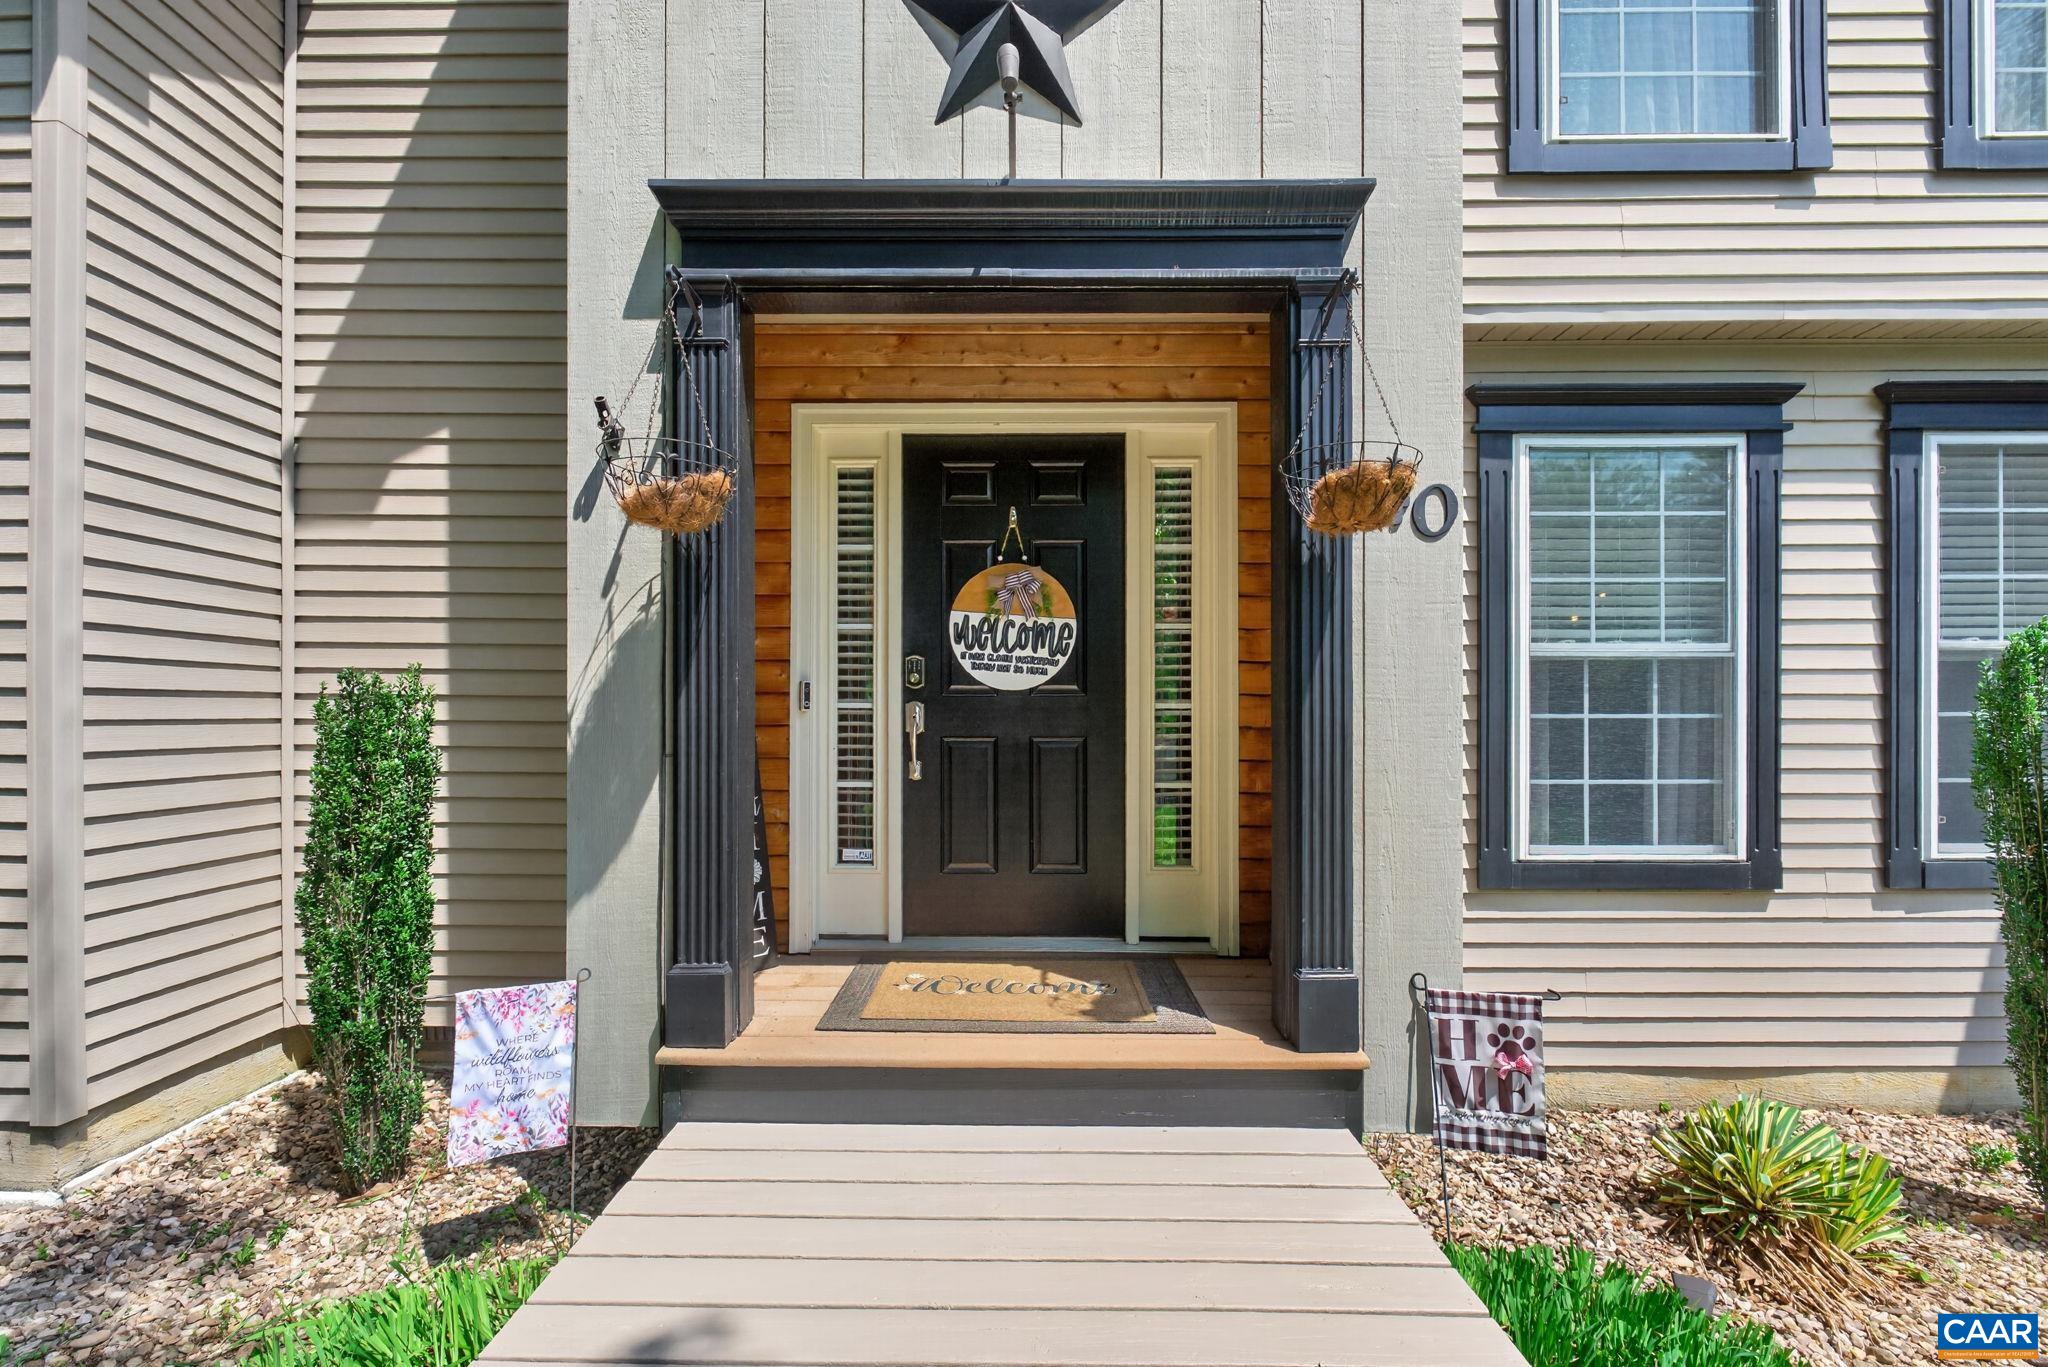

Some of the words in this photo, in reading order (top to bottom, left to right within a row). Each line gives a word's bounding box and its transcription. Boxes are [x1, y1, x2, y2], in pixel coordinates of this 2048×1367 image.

[894, 974, 1118, 996] Welcome
[496, 1033, 539, 1047] WHERE
[471, 1044, 560, 1068] wildflowers
[464, 1082, 484, 1093] MY
[487, 1076, 525, 1089] HEART
[528, 1070, 562, 1083] FINDS
[495, 1087, 536, 1106] home
